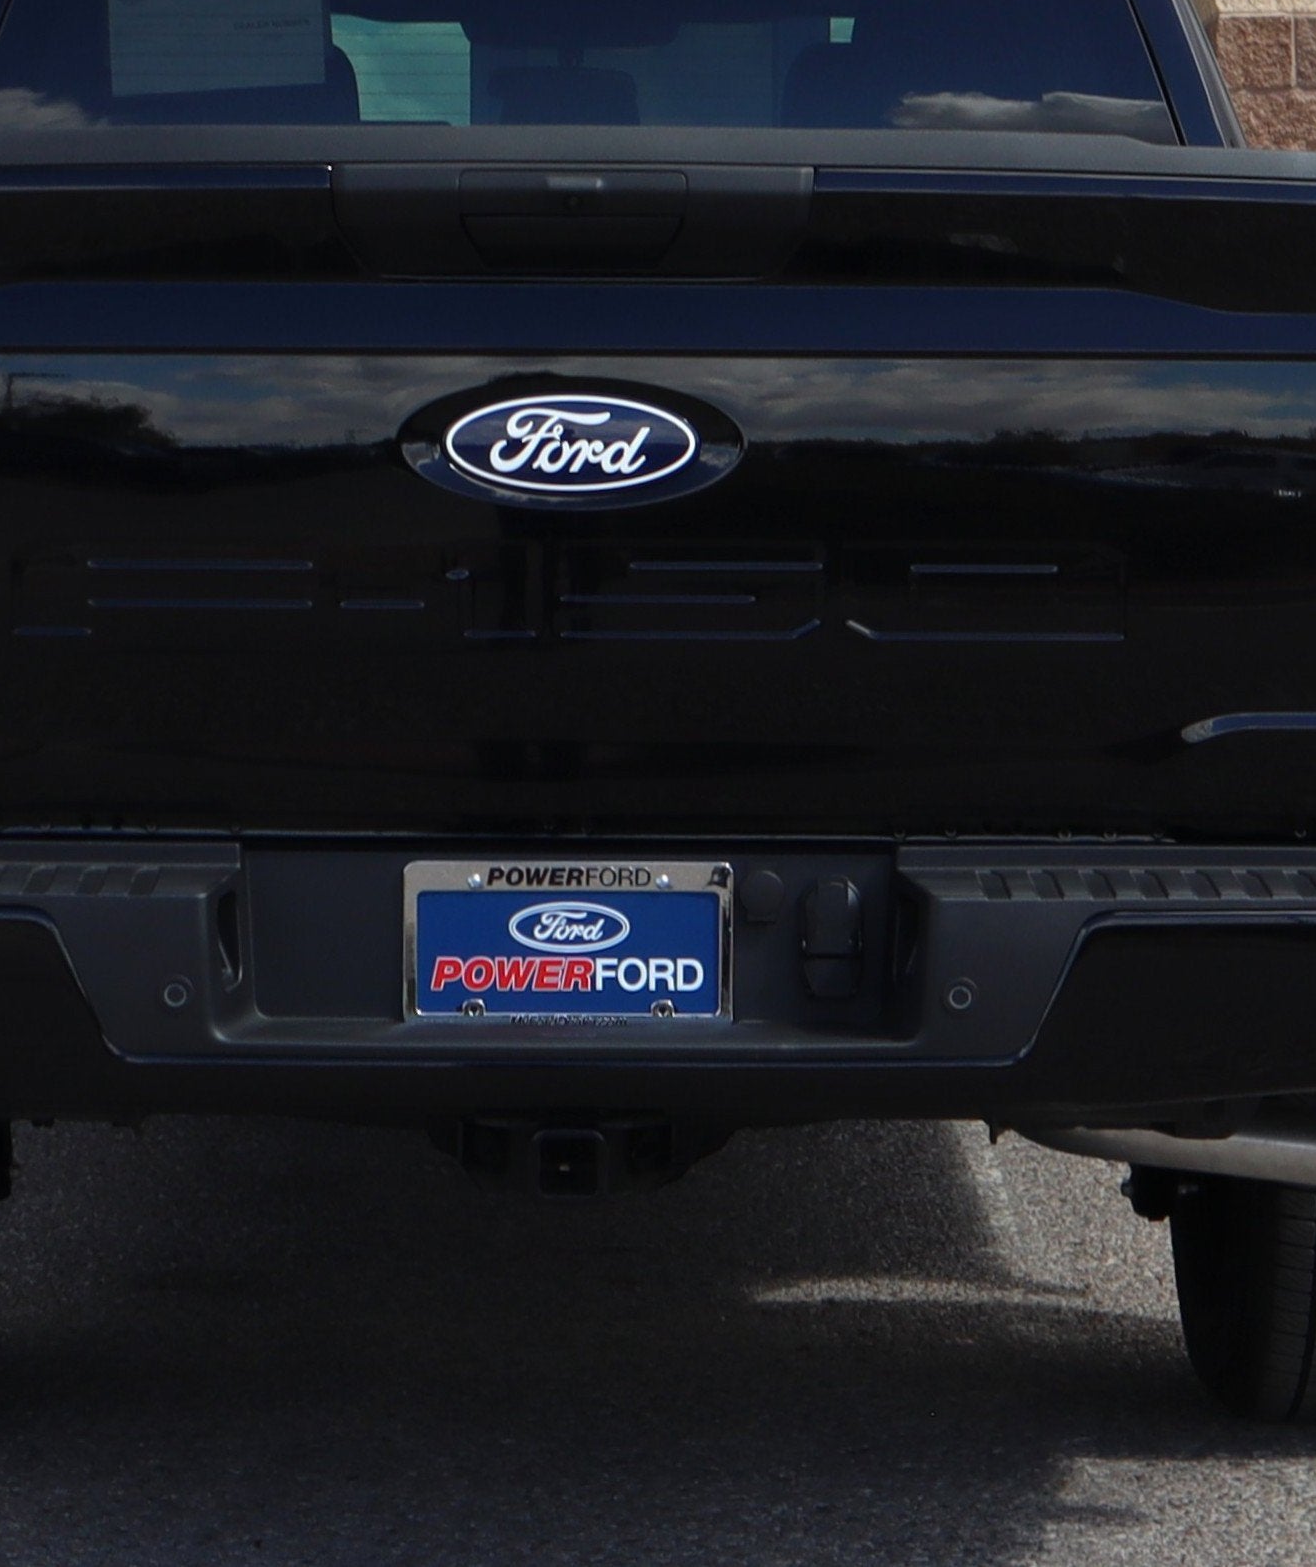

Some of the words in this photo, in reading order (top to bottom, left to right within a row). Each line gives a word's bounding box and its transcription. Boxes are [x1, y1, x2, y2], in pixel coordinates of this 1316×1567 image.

[489, 407, 651, 475] Ford
[486, 866, 652, 888] POWERFORD
[533, 910, 604, 942] Ford
[430, 956, 704, 992] POWERFORD
